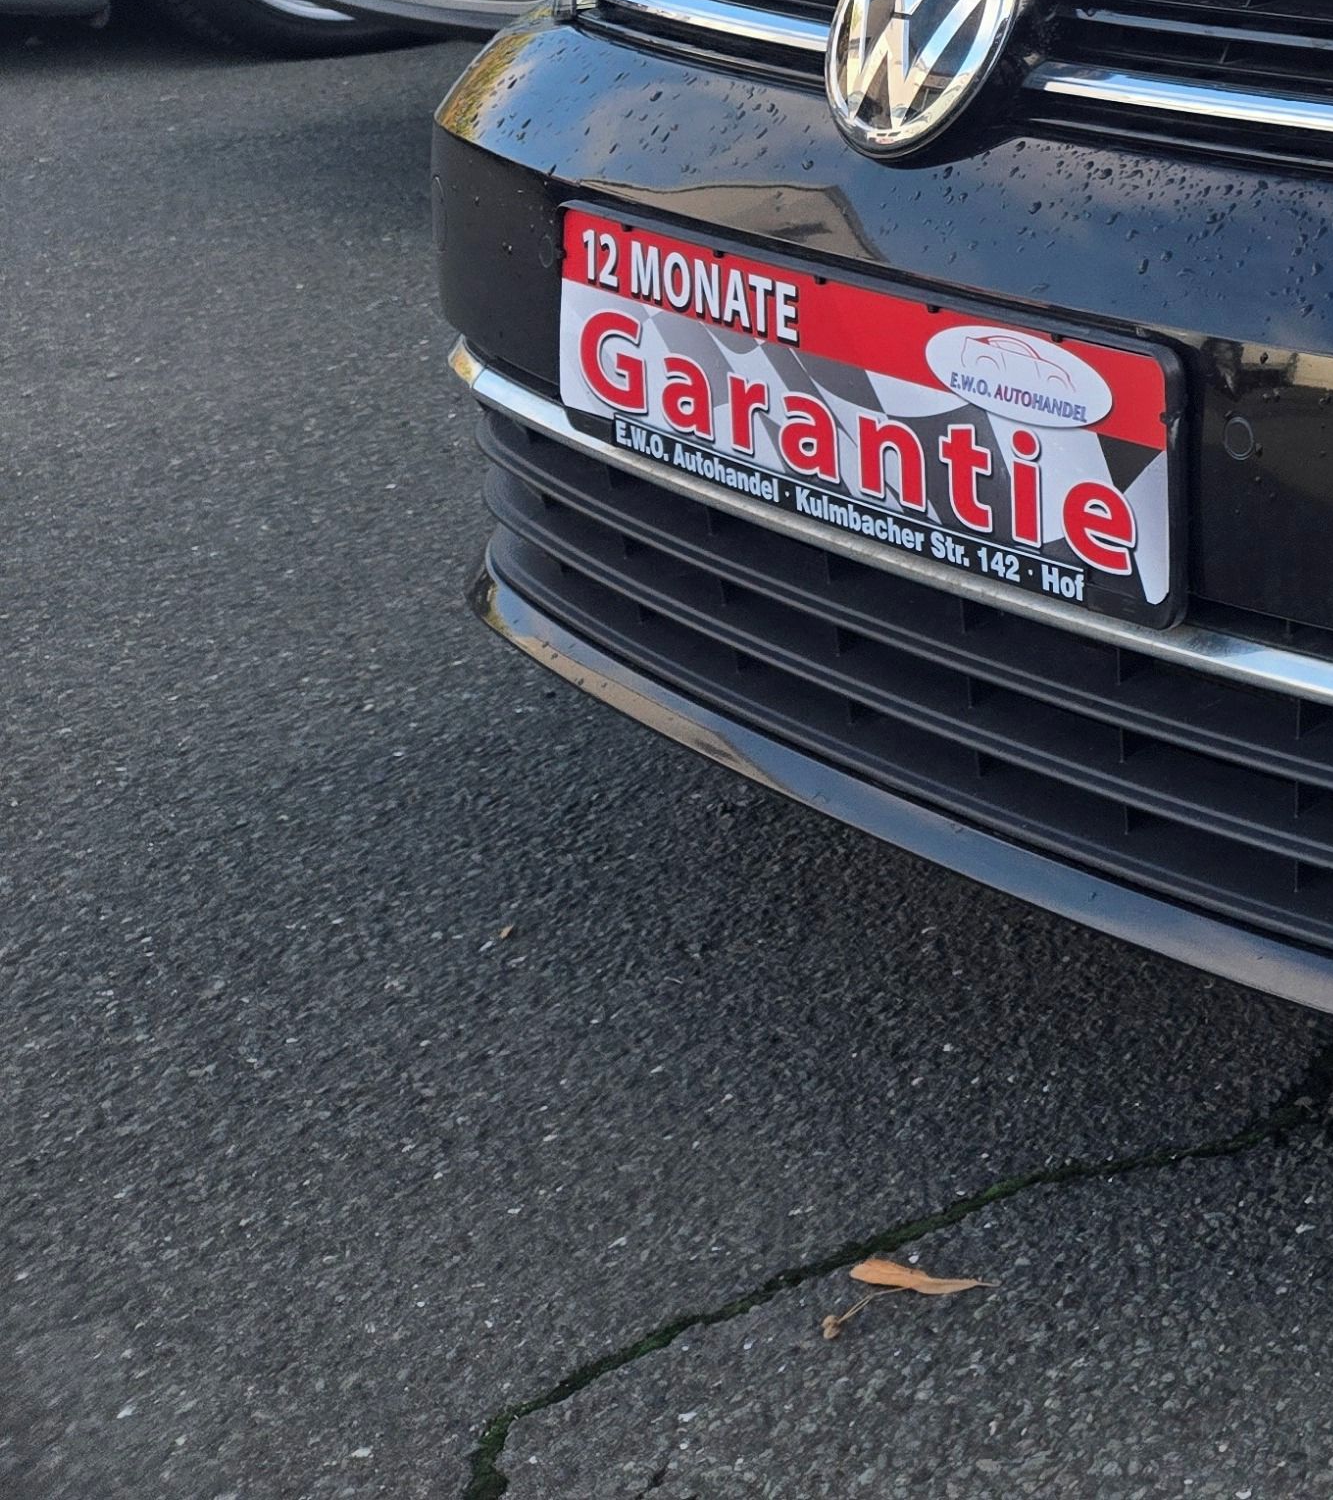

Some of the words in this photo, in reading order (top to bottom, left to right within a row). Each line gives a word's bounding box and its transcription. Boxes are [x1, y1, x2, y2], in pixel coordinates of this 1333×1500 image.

[582, 229, 619, 289] 12
[631, 241, 800, 347] MONATE
[579, 310, 1135, 575] Garantie
[950, 372, 991, 398] E.W.O.
[994, 384, 1088, 423] AUTOHANDEL
[615, 419, 669, 463] E.W.O.
[673, 443, 780, 503] Autohandel
[795, 485, 924, 552] Kulmbacher
[930, 531, 970, 567] Str.
[977, 547, 1020, 583] 142
[1042, 564, 1085, 602] Hof
